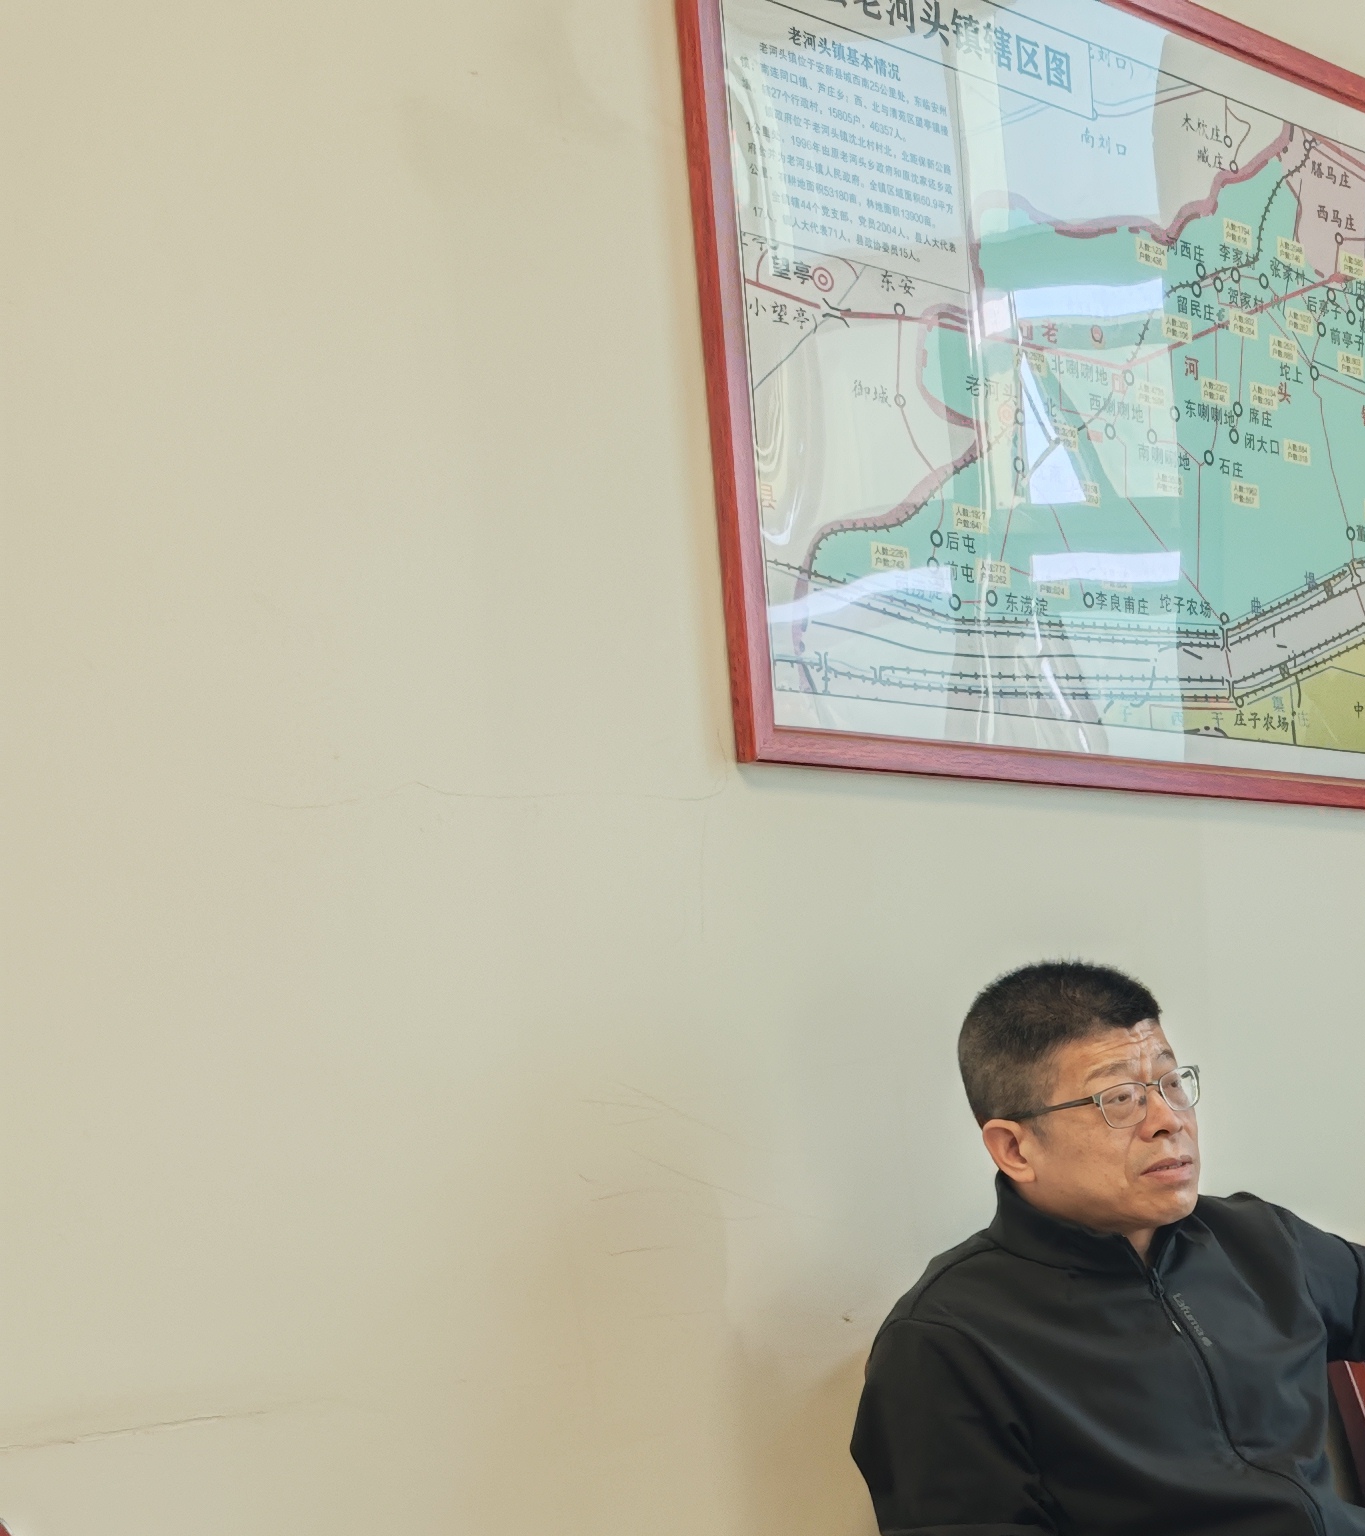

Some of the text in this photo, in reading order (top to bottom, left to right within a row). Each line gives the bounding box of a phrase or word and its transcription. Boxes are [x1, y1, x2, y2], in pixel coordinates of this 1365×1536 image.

[788, 26, 901, 81] 老河头镇基本情况
[1316, 204, 1357, 231] 西马庄
[771, 254, 813, 285] 望亭
[881, 269, 916, 297] 东安
[1184, 355, 1199, 381] 河
[1277, 382, 1291, 404] 头
[1219, 457, 1244, 478] 石庄
[945, 531, 977, 554] 后屯
[1233, 710, 1290, 732] 庄子农场
